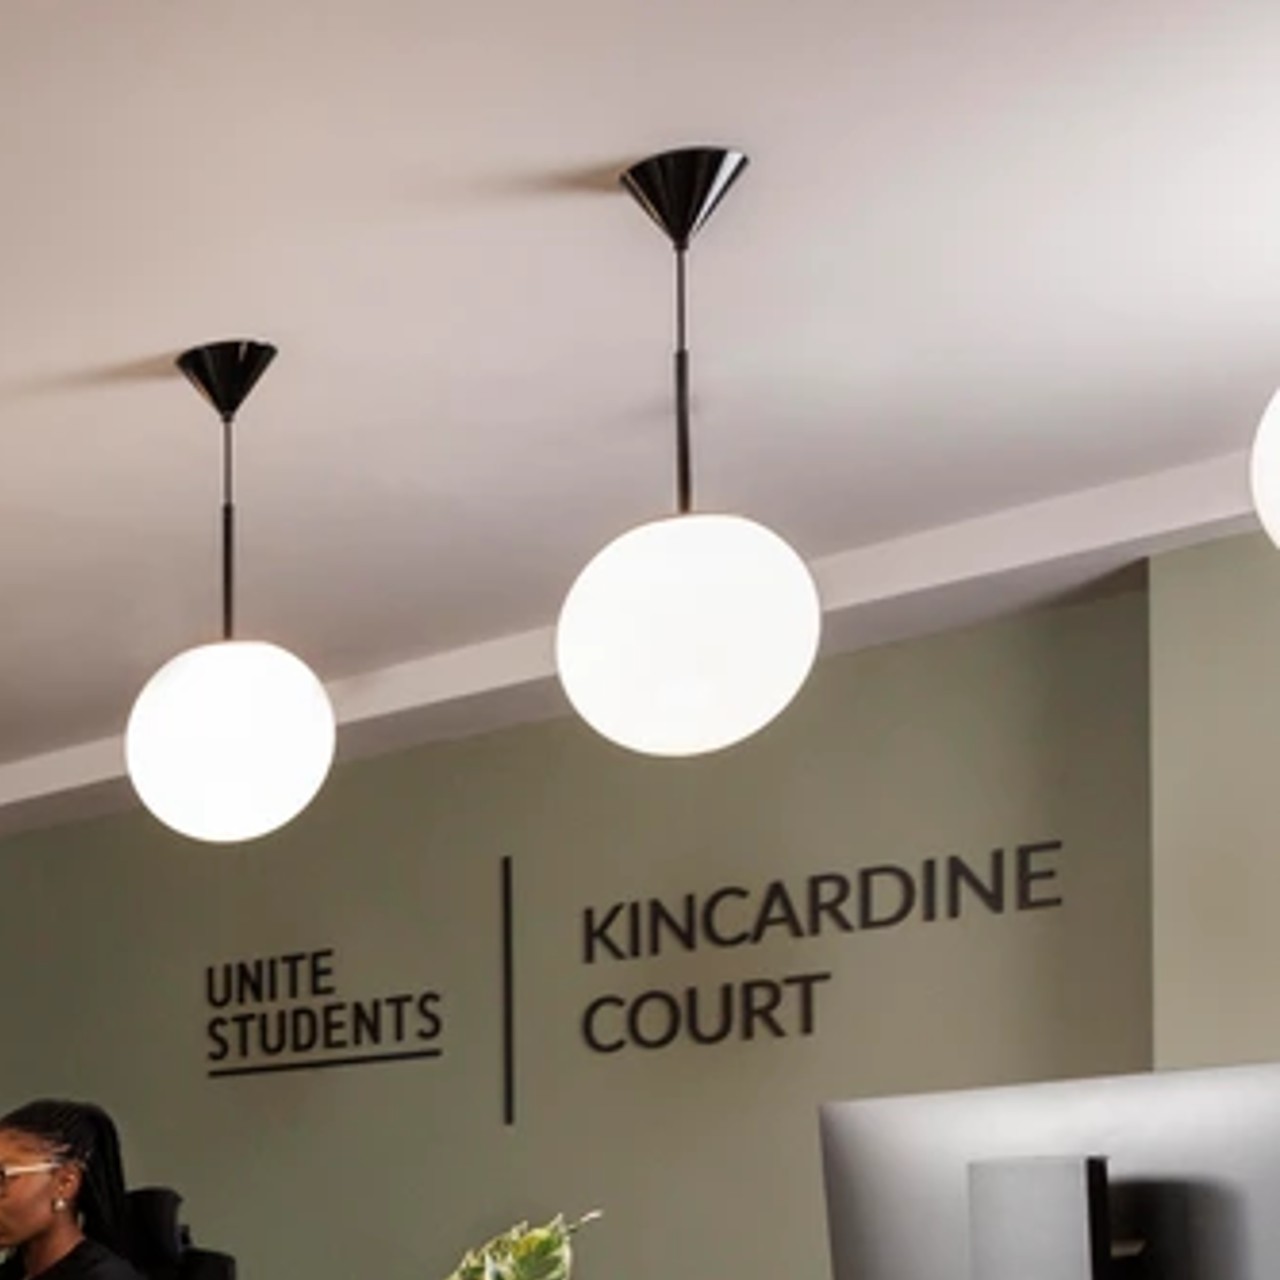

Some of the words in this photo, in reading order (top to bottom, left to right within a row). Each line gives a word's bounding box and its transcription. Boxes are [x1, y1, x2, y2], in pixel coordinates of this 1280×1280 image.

[581, 840, 1065, 965] KINCARDINE
[205, 948, 336, 1008] UNITE
[581, 972, 833, 1056] COURT
[205, 992, 443, 1062] STUDENTS
